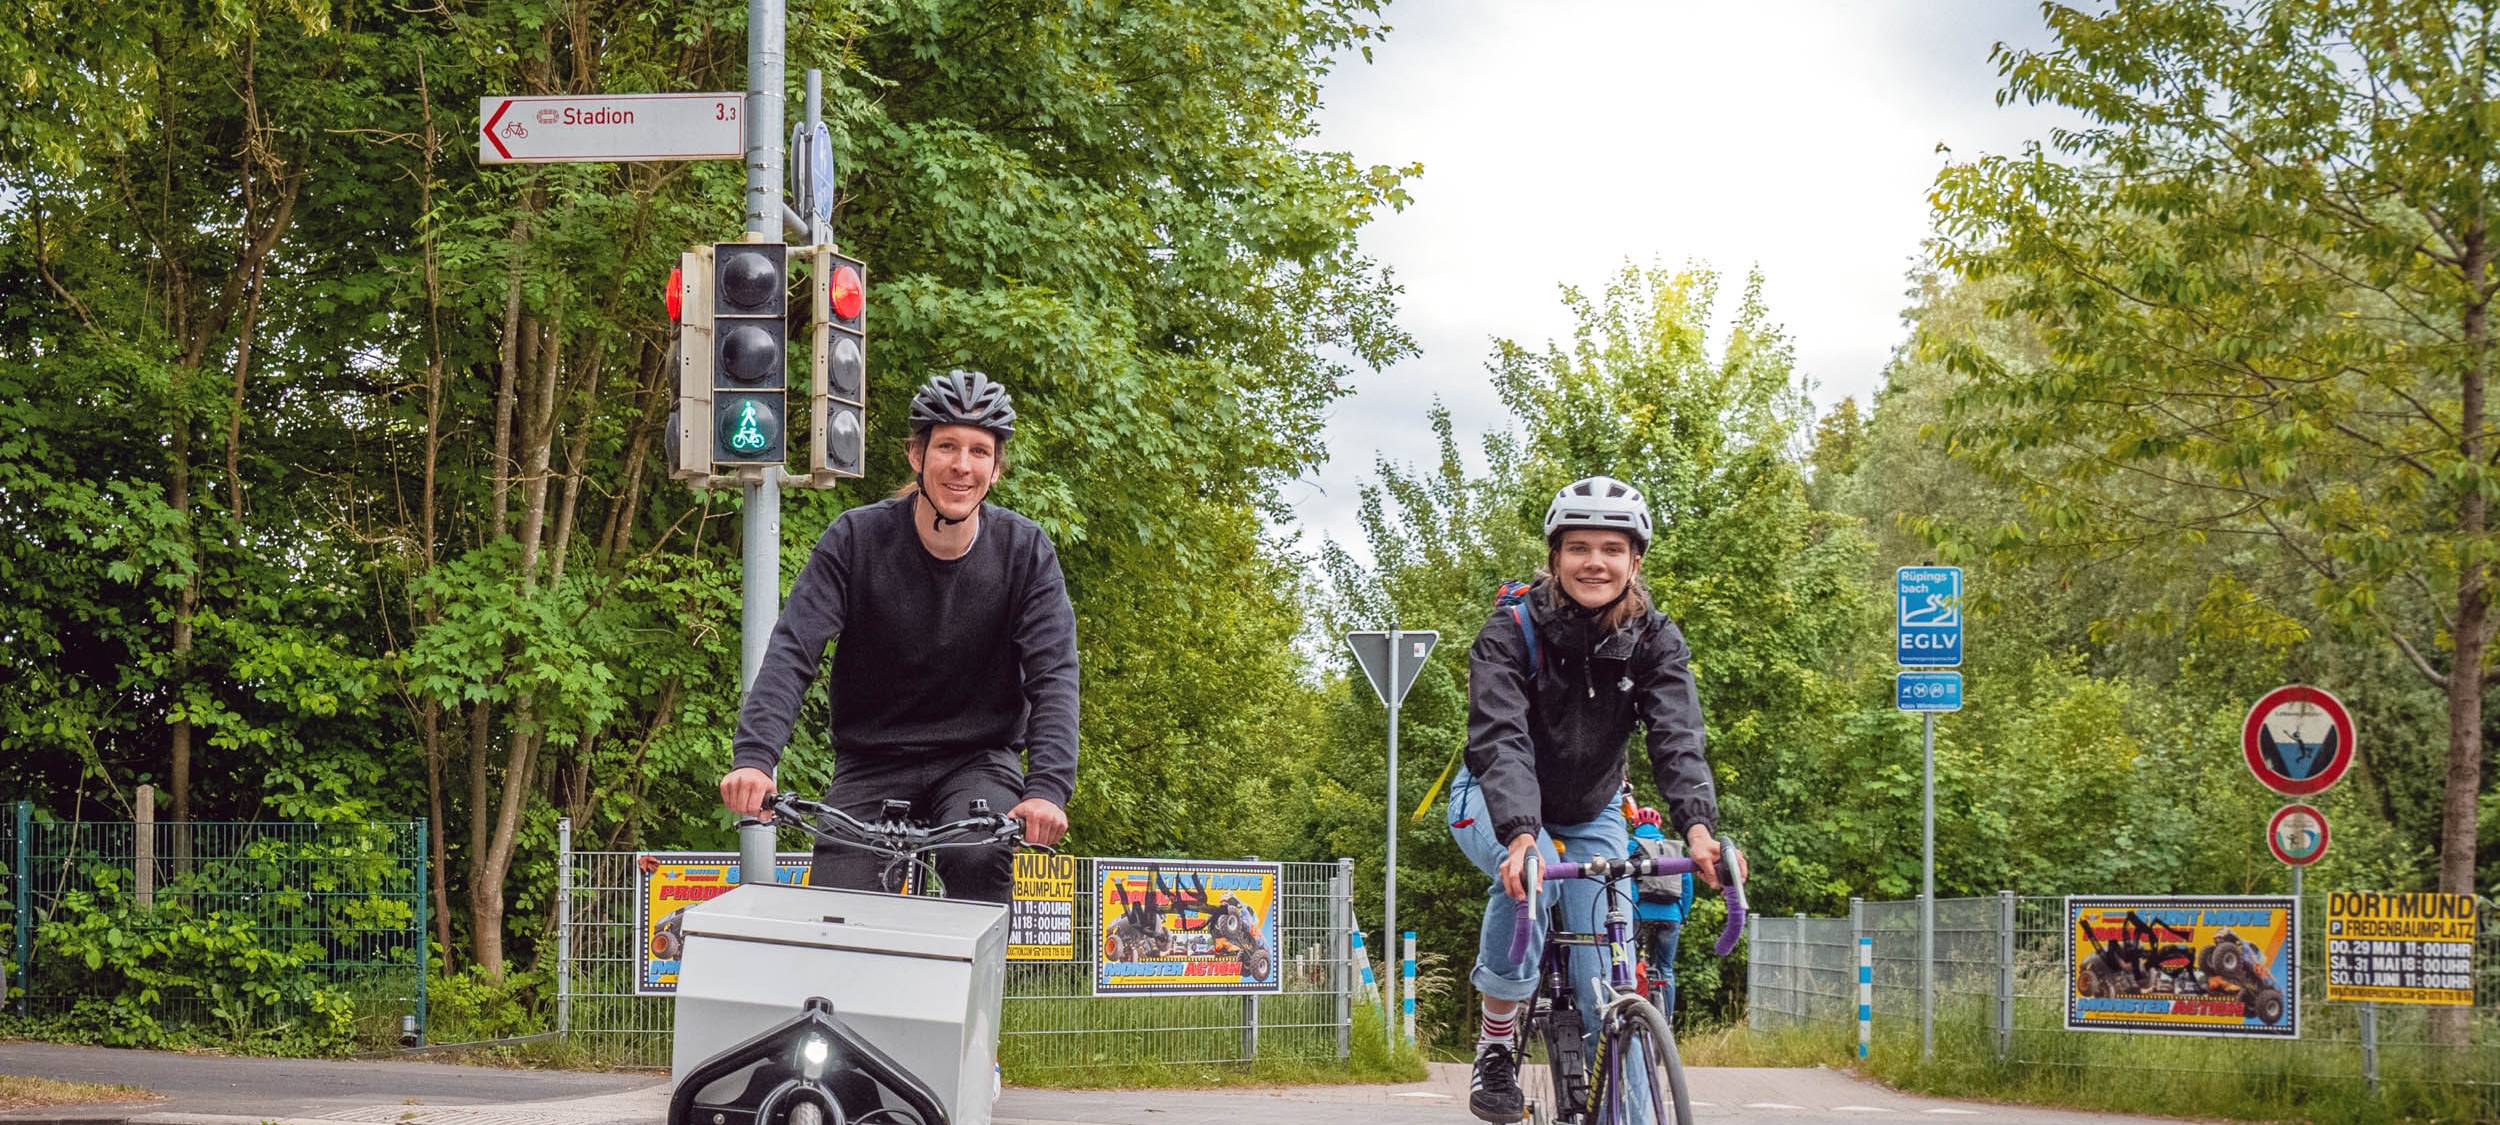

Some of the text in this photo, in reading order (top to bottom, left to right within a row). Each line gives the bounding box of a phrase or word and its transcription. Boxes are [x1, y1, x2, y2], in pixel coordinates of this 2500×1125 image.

[563, 107, 635, 126] Stadion
[1901, 634, 1957, 649] EGLV
[1013, 855, 1073, 879] MUND
[1211, 874, 1263, 890] MOVIE
[1051, 902, 1072, 916] UHR
[2330, 893, 2475, 919] DORTMUND
[1051, 917, 1072, 930] UHR
[2346, 920, 2473, 938] FREDENBAUMPLATZ
[1051, 932, 1072, 944] UHR
[2330, 940, 2351, 954] DO.
[2352, 941, 2370, 954] 29
[2372, 941, 2400, 955] MAI
[2442, 943, 2472, 957] UHR
[1104, 961, 1242, 977] MONSTER ACTION
[2330, 956, 2472, 973] SA. 31 MAI 18:00 UHR
[2330, 971, 2352, 985] SO.
[2354, 972, 2370, 985] 01
[2372, 973, 2400, 987] JUNI
[2442, 974, 2472, 989] UHR
